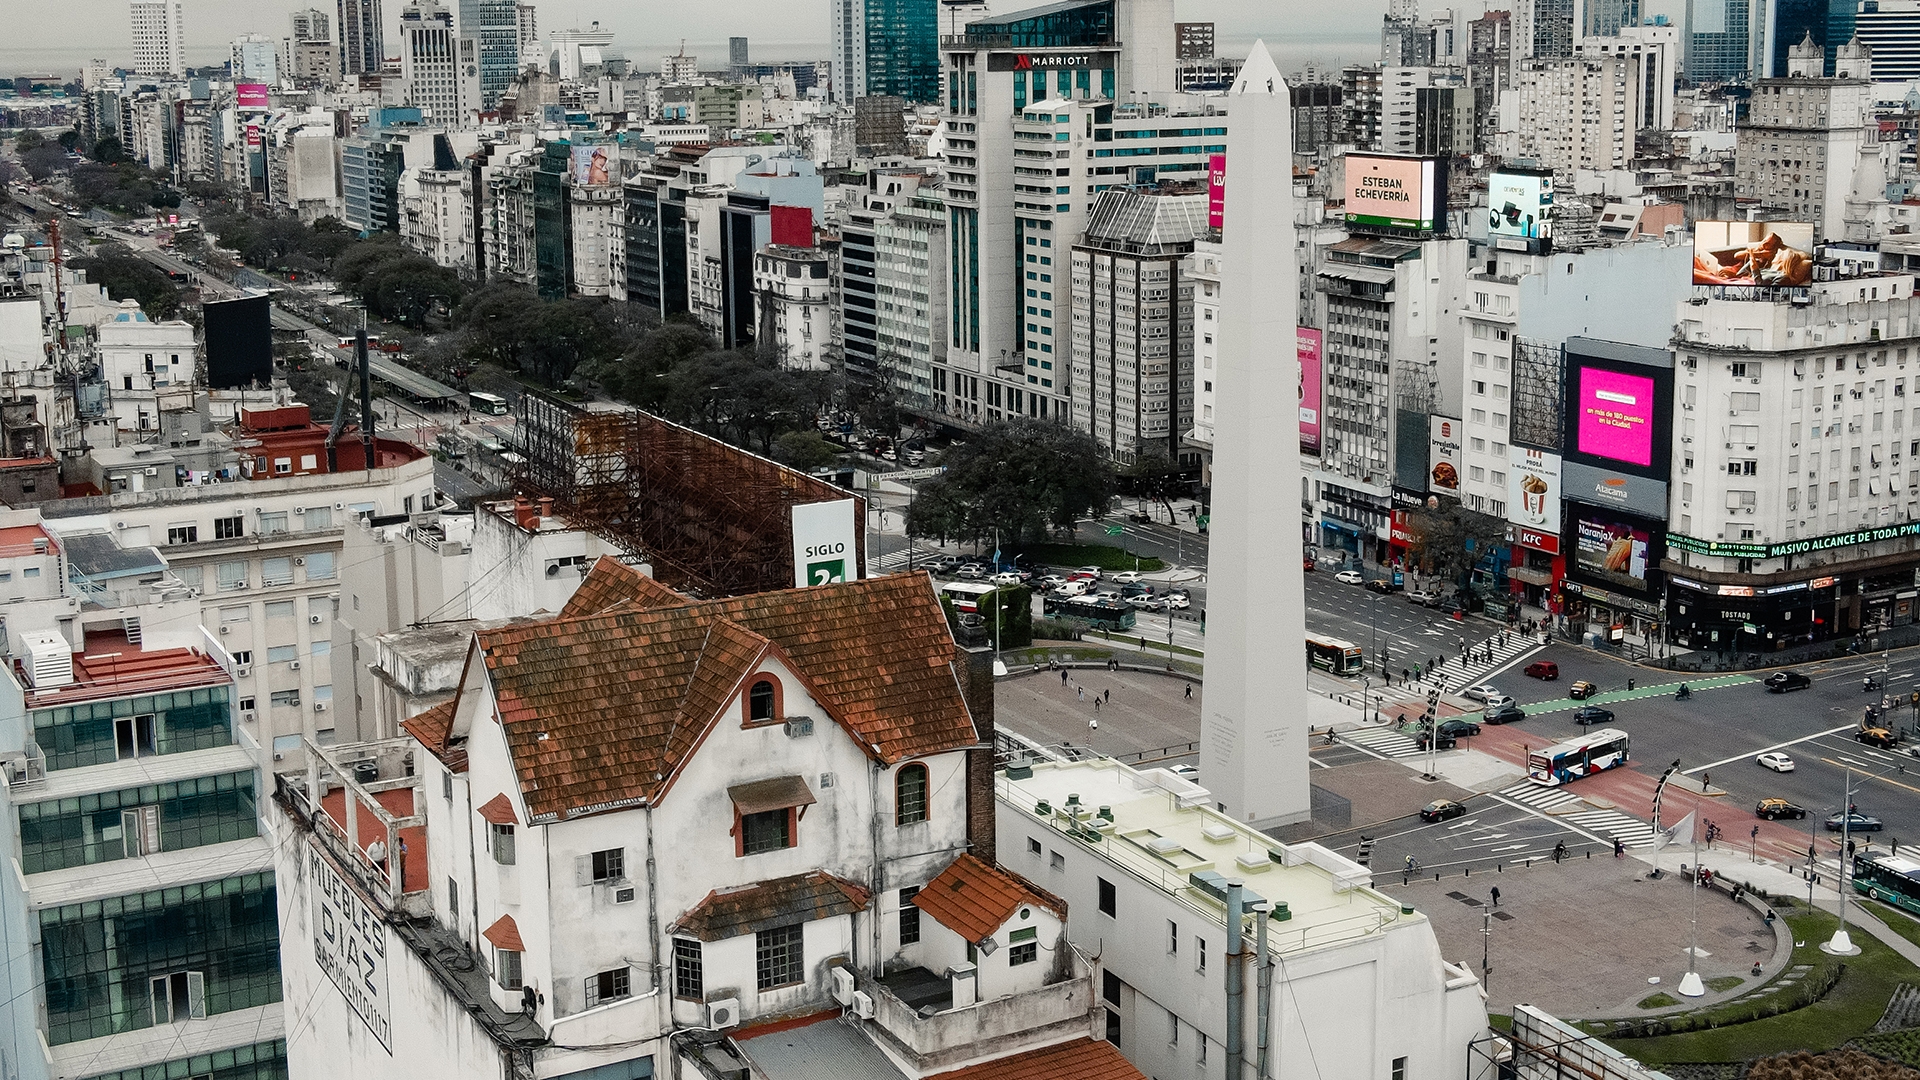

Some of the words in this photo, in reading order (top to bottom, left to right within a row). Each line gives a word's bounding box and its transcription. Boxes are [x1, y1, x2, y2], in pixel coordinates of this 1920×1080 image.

[1032, 56, 1089, 66] MARRIOTT
[1362, 176, 1402, 189] ESTEBAN
[1355, 188, 1410, 203] ECHEVERRÍA
[1594, 408, 1605, 416] más
[1624, 415, 1644, 424] puestos
[1440, 448, 1452, 456] King
[1392, 490, 1400, 500] La
[1595, 484, 1628, 498] Atacama
[1522, 532, 1542, 546] KFC
[1684, 538, 1708, 548] PUBLICIDAD
[1771, 541, 1810, 556] MASIVO
[1812, 534, 1856, 550] ALCANCE
[1858, 532, 1870, 543] DE
[1872, 528, 1898, 540] TODA
[806, 542, 844, 558] SIGLO
[1566, 582, 1582, 592] GIFTS
[1721, 610, 1750, 619] TOSTADO
[310, 850, 385, 959] MUEBLES
[322, 902, 377, 997] DIAZ
